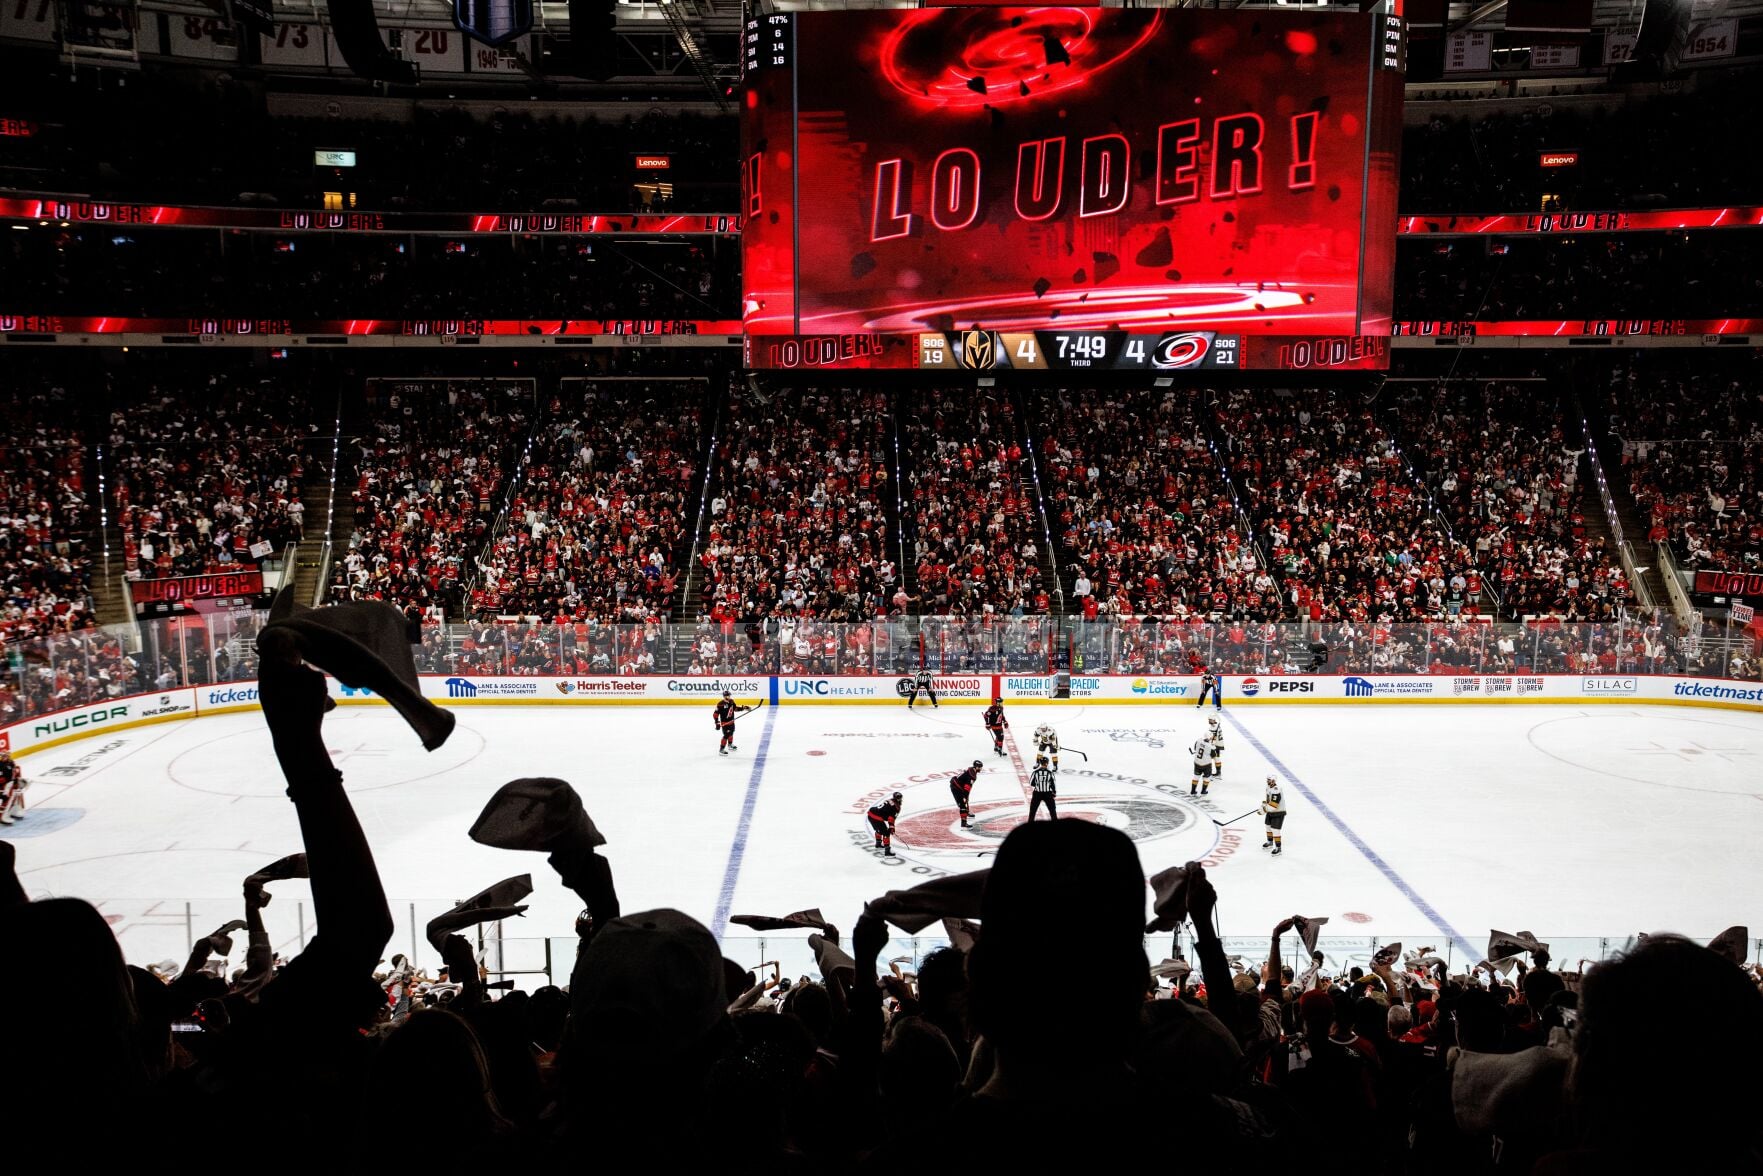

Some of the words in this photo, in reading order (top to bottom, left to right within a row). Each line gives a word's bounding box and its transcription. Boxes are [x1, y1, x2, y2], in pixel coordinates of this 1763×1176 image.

[768, 16, 788, 25] 47%
[1387, 17, 1401, 27] FO%
[774, 29, 782, 38] 6
[1386, 31, 1400, 40] PIM
[773, 42, 785, 51] 14
[1690, 35, 1727, 54] 1954
[773, 56, 785, 65] 16
[1384, 57, 1398, 67] GVA
[638, 158, 667, 167] Lenovo
[1543, 155, 1575, 166] Lenovo
[870, 109, 1321, 243] LOUDER!
[923, 338, 944, 348] SOG
[1056, 336, 1106, 358] 7:49
[1215, 339, 1236, 348] SOG
[770, 333, 883, 368] LOUDER!
[1016, 340, 1036, 362] 4
[1125, 340, 1146, 362] 4
[1280, 335, 1384, 368] LOUDER!
[924, 350, 943, 363] 19
[1216, 351, 1235, 364] 21
[1070, 359, 1092, 367] THIRD
[577, 680, 610, 691] Harris
[611, 680, 647, 691] Teeter
[667, 679, 759, 692] Groundworks
[932, 679, 981, 690] NNWOOD
[1008, 678, 1042, 690] RALEIGH
[1453, 677, 1473, 685] STORM
[1485, 677, 1505, 685] STORM
[1517, 677, 1537, 685] STORM
[1587, 679, 1633, 689] SILAC
[784, 679, 829, 696] UNC
[830, 686, 875, 695] HEALTH
[1149, 685, 1188, 696] Lottery
[1269, 681, 1314, 693] PEPSI
[1463, 684, 1480, 692] BREW
[1495, 684, 1512, 692] BREW
[1527, 684, 1544, 692] BREW
[35, 705, 128, 738] NUCOR
[1197, 747, 1205, 760] 9
[1060, 768, 1149, 785] enovo
